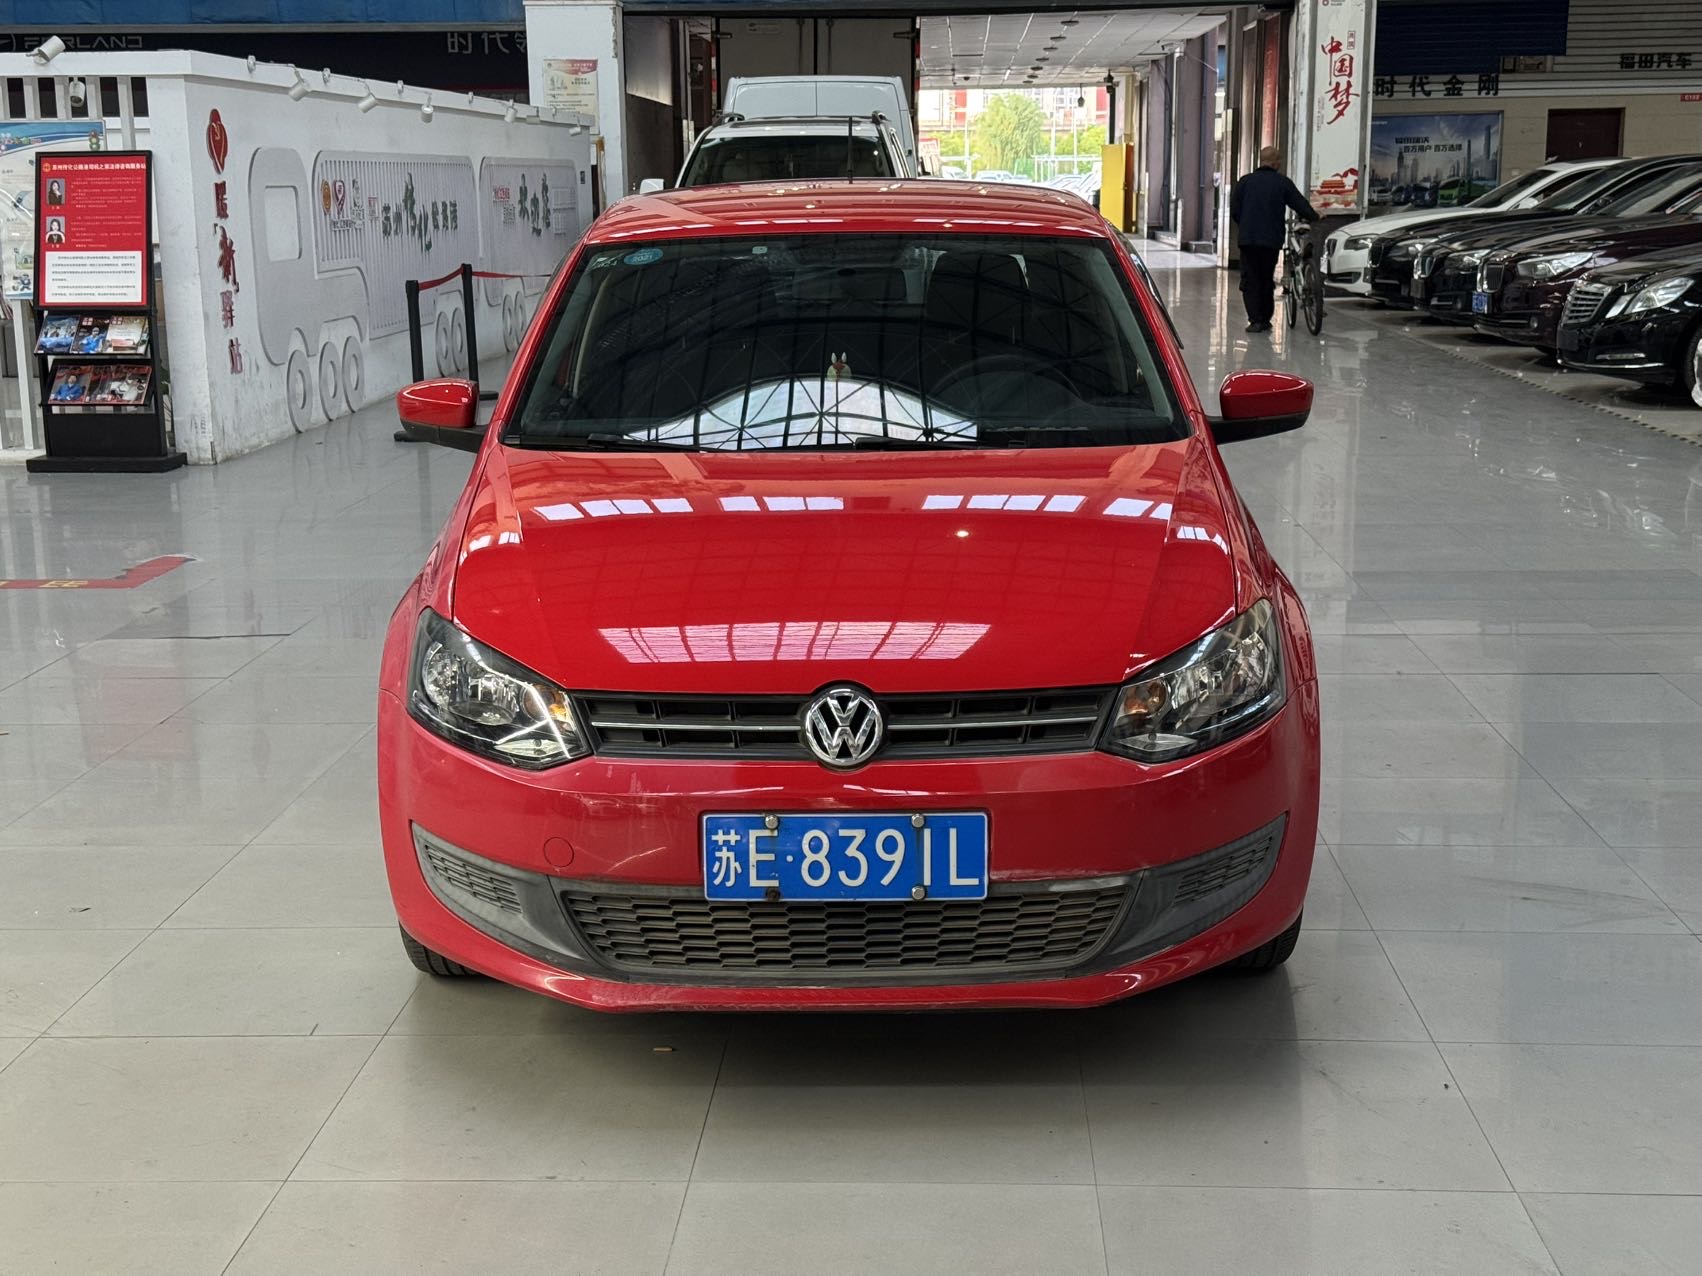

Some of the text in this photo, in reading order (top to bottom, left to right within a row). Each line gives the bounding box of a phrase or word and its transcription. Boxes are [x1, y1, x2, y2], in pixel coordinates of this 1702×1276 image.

[24, 36, 142, 49] FRLAND
[1620, 53, 1692, 69] 福田汽车
[1320, 36, 1360, 125] 中国梦
[1374, 74, 1500, 98] 时代金刚
[711, 827, 981, 888] 苏E·8391L
